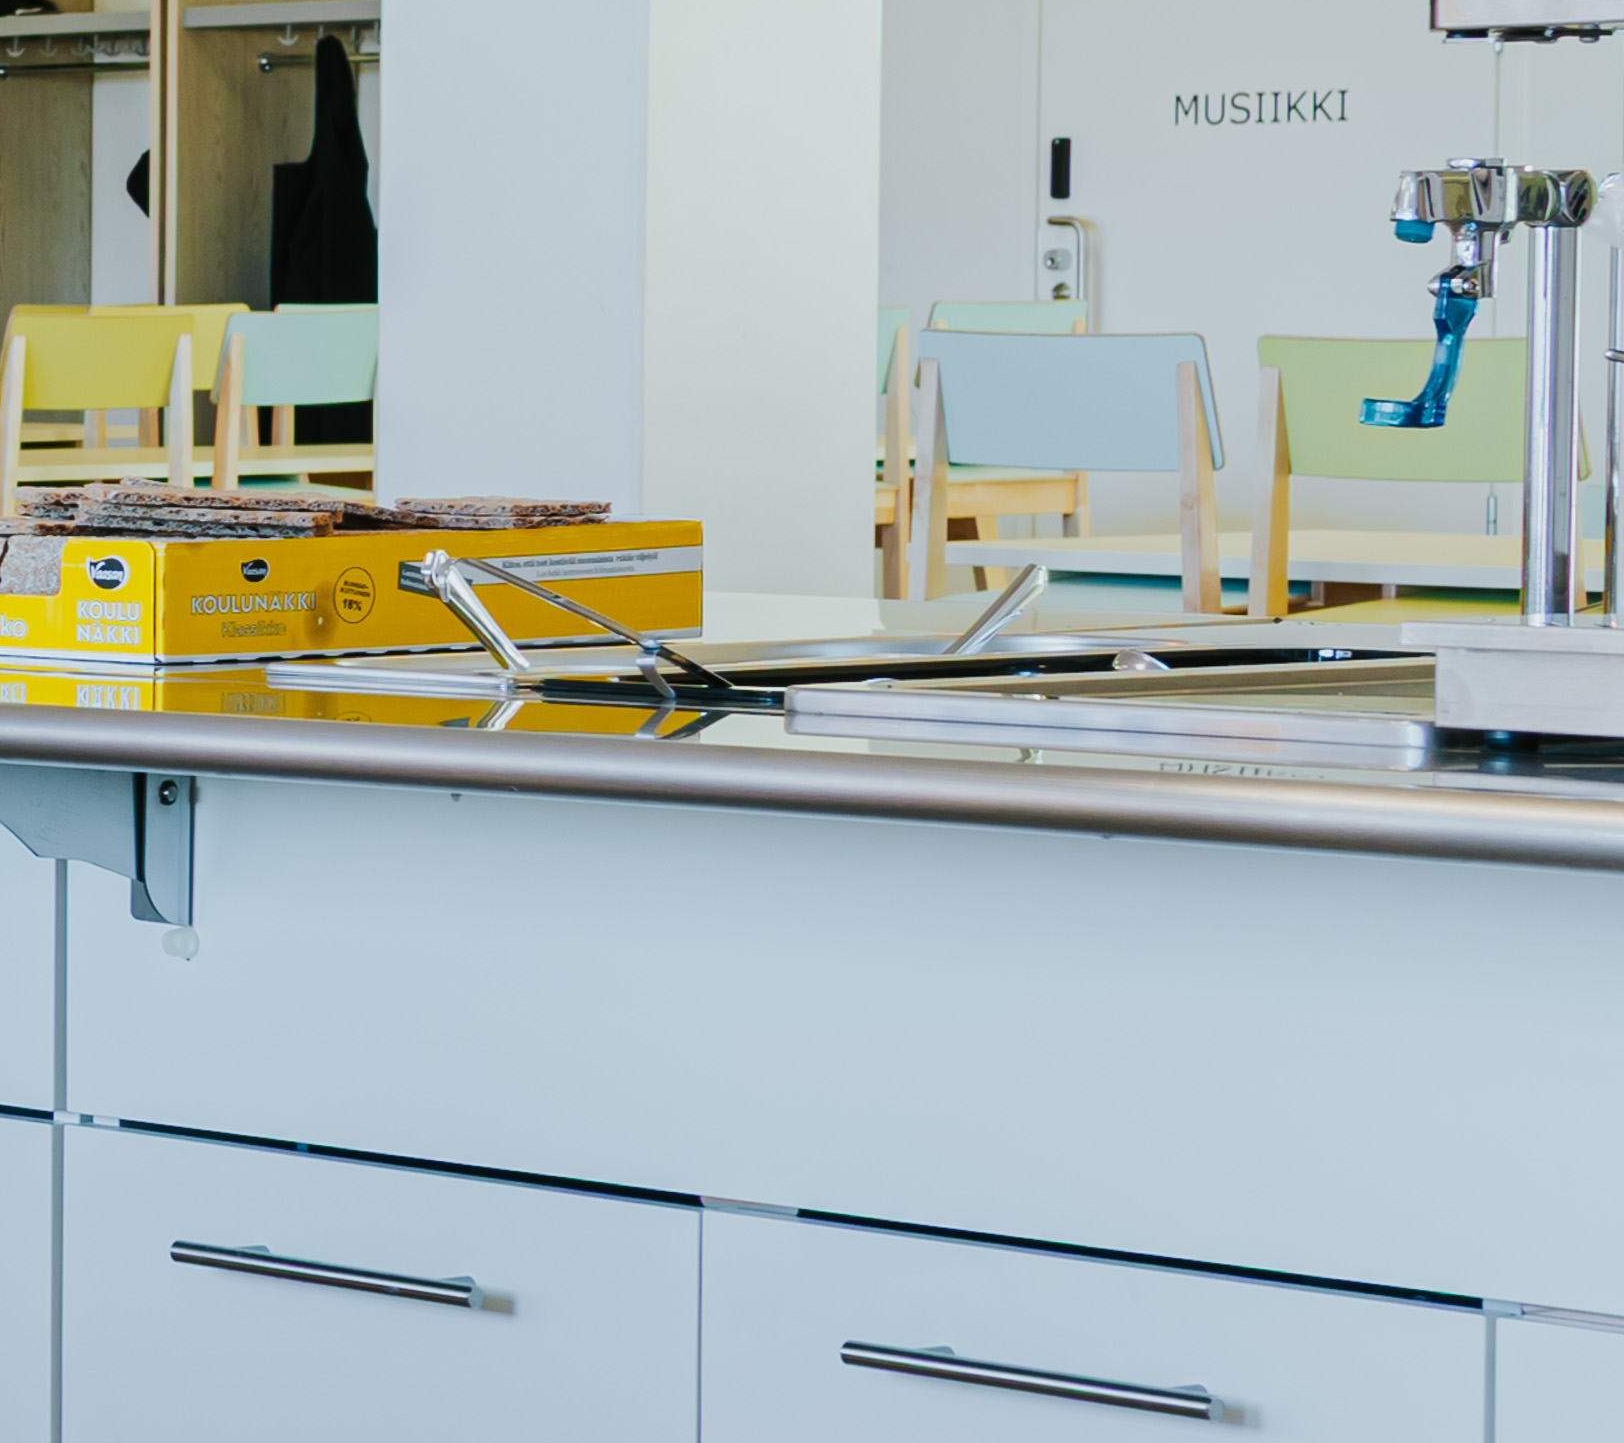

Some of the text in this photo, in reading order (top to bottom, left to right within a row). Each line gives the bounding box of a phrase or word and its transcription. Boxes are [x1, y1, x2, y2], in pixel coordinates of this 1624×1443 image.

[1174, 89, 1350, 126] MUSIIKKI
[77, 600, 141, 623] KOULU
[191, 591, 316, 615] KOULUNÄKKI
[76, 623, 141, 646] NÄKKI
[221, 620, 286, 638] Klassikko
